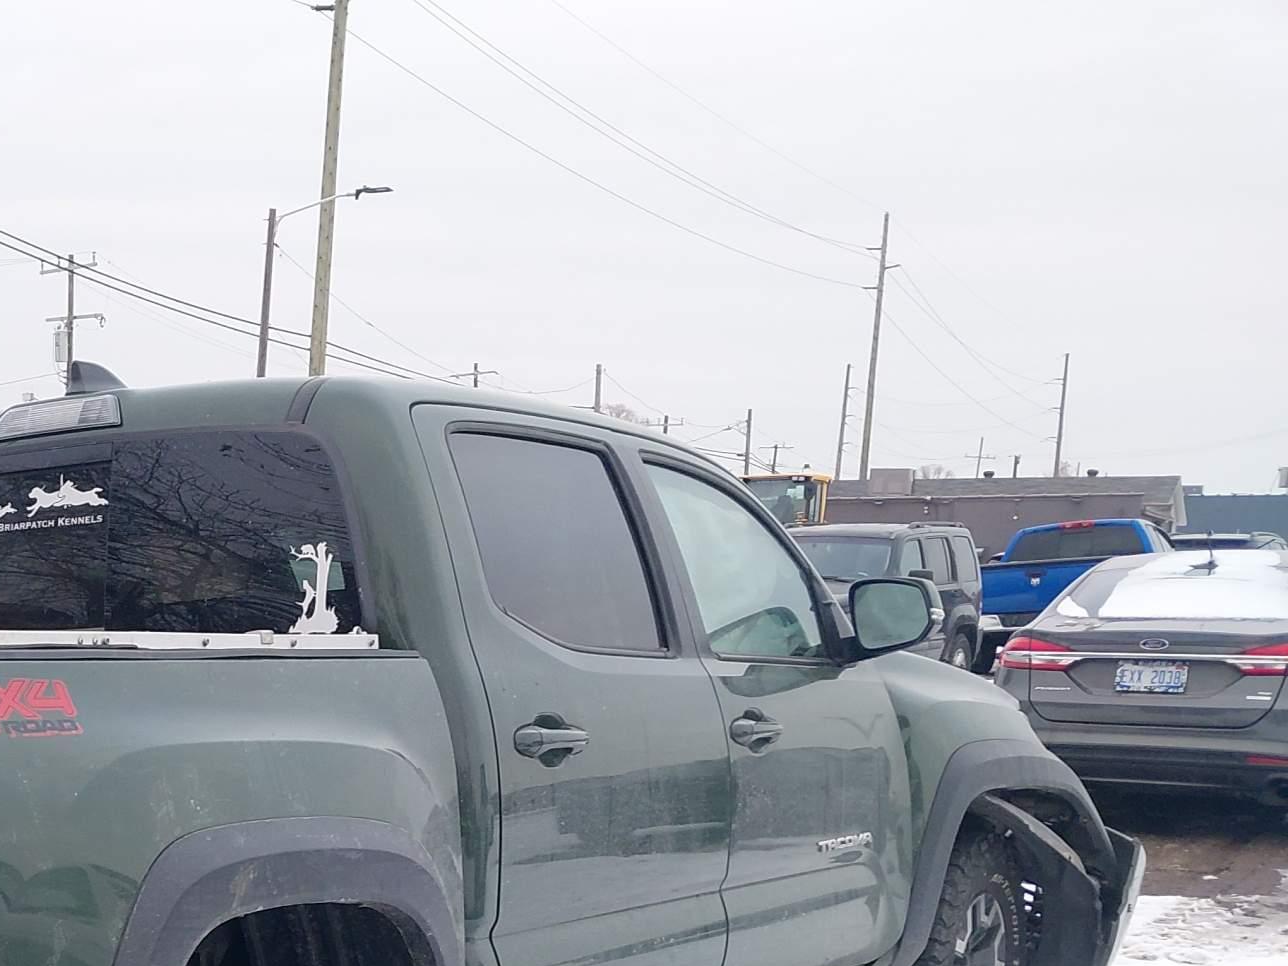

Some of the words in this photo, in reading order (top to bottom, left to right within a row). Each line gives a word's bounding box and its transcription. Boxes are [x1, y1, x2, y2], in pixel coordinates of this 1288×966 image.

[58, 515, 103, 527] KENNELS
[3, 718, 85, 739] ROAD
[816, 831, 873, 852] TACOMA
